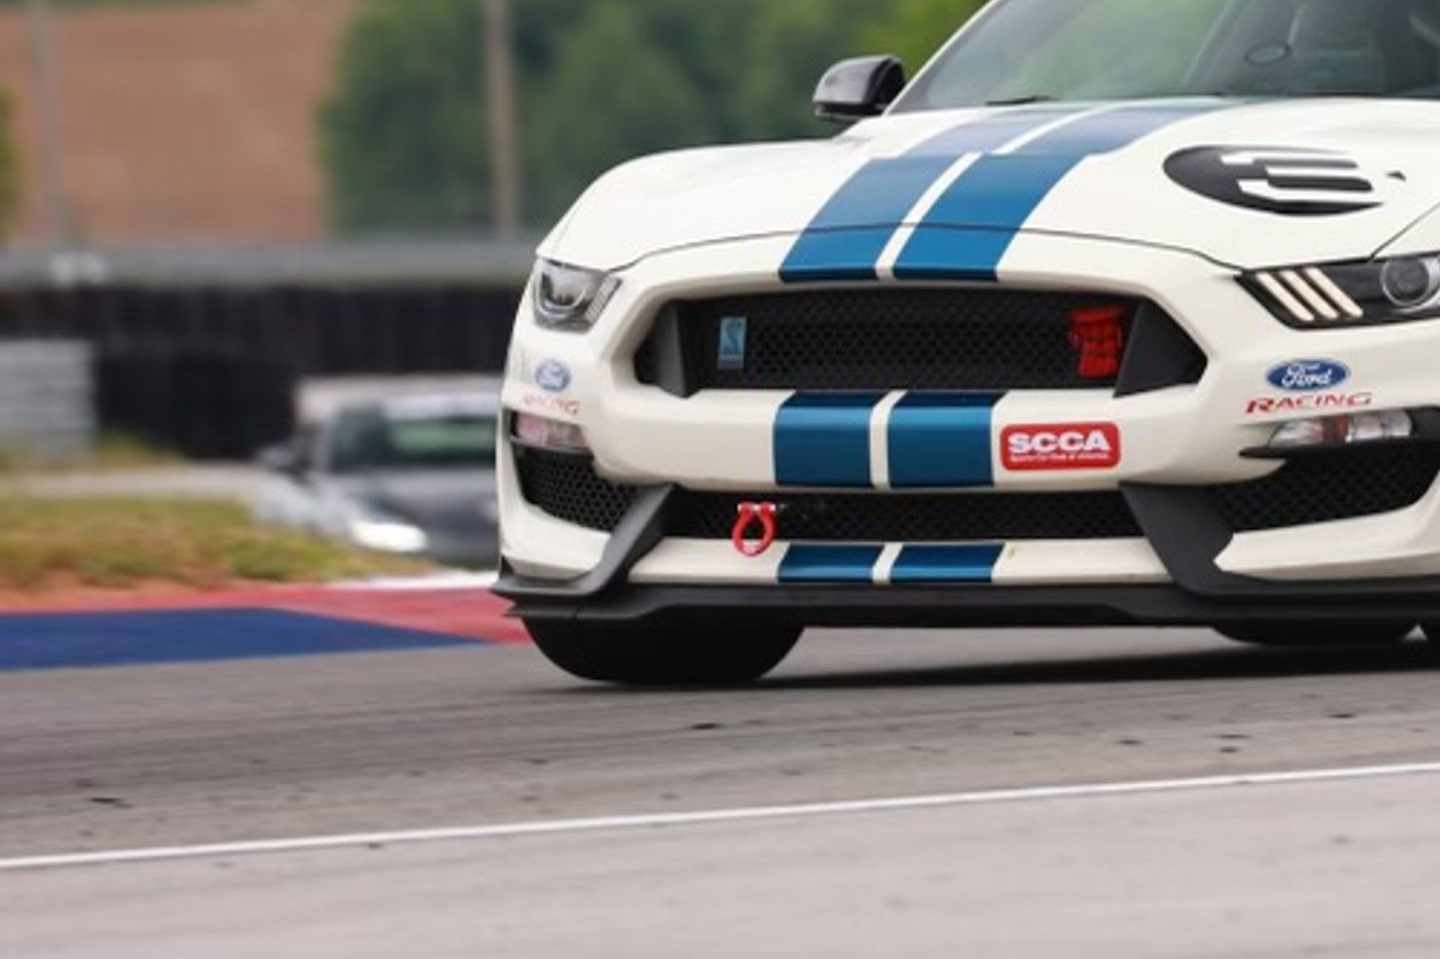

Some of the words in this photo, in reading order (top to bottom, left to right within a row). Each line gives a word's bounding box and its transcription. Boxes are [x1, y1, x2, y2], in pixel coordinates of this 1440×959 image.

[1280, 362, 1334, 388] Ford
[1246, 392, 1373, 414] RACING
[1008, 429, 1111, 454] SCCA
